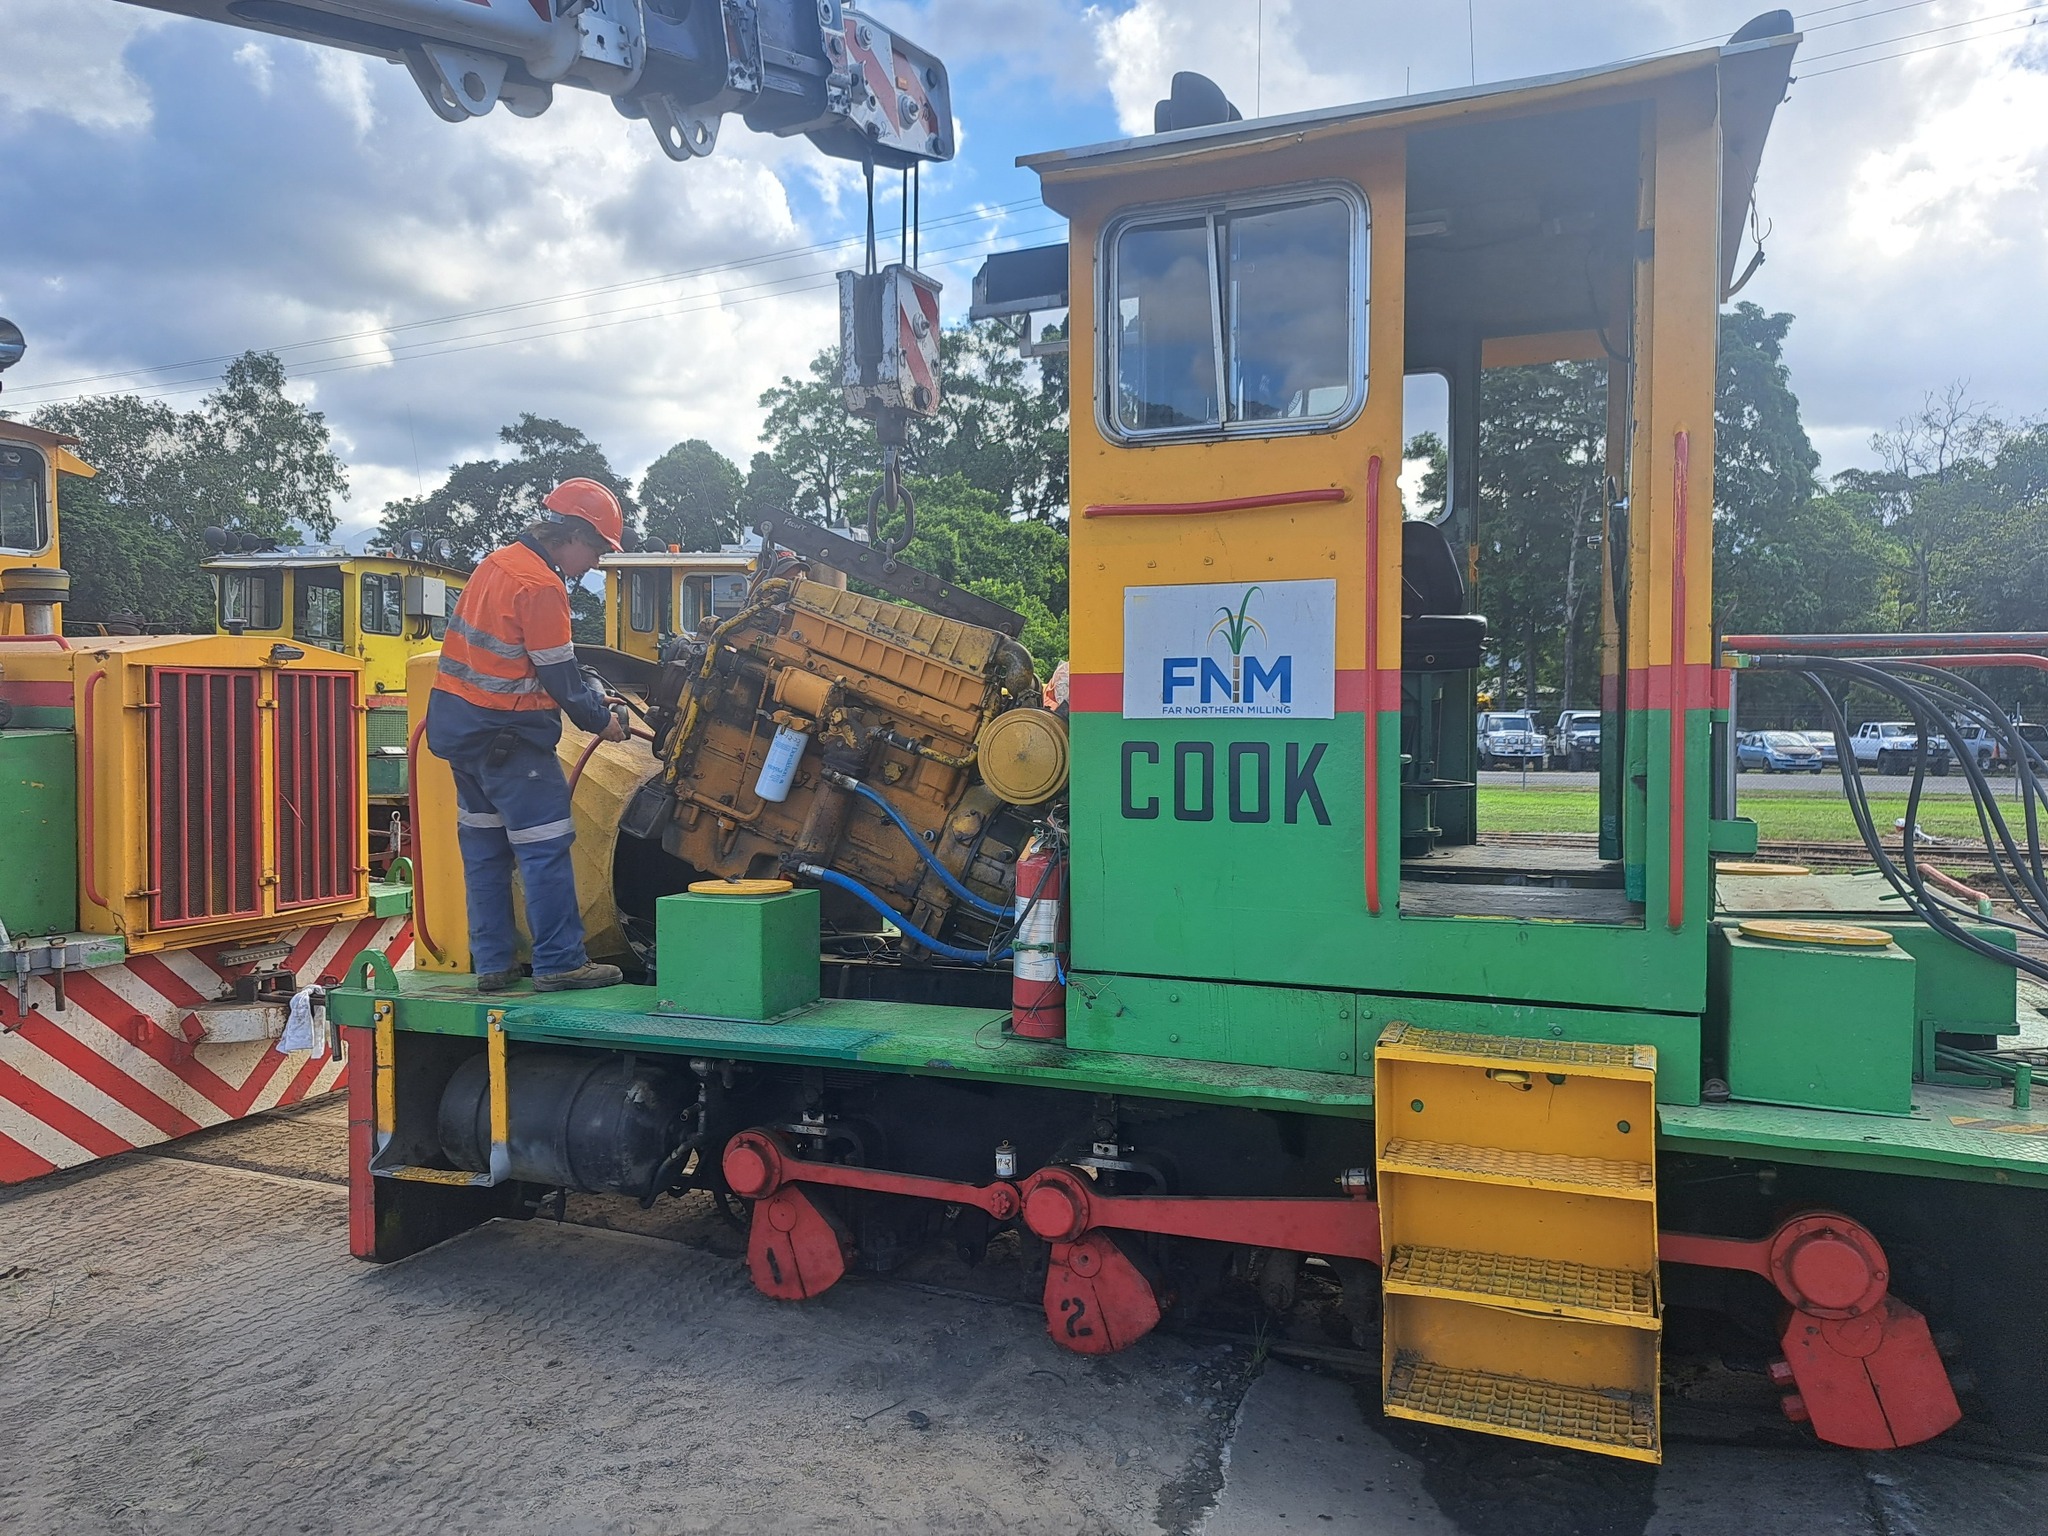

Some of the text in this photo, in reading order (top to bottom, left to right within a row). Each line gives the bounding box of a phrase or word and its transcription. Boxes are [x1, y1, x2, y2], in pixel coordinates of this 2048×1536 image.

[1162, 655, 1292, 704] FNM
[1162, 705, 1291, 715] FAR NORTHERN MILLING
[1121, 741, 1332, 826] COOK
[1061, 1297, 1092, 1338] 2
